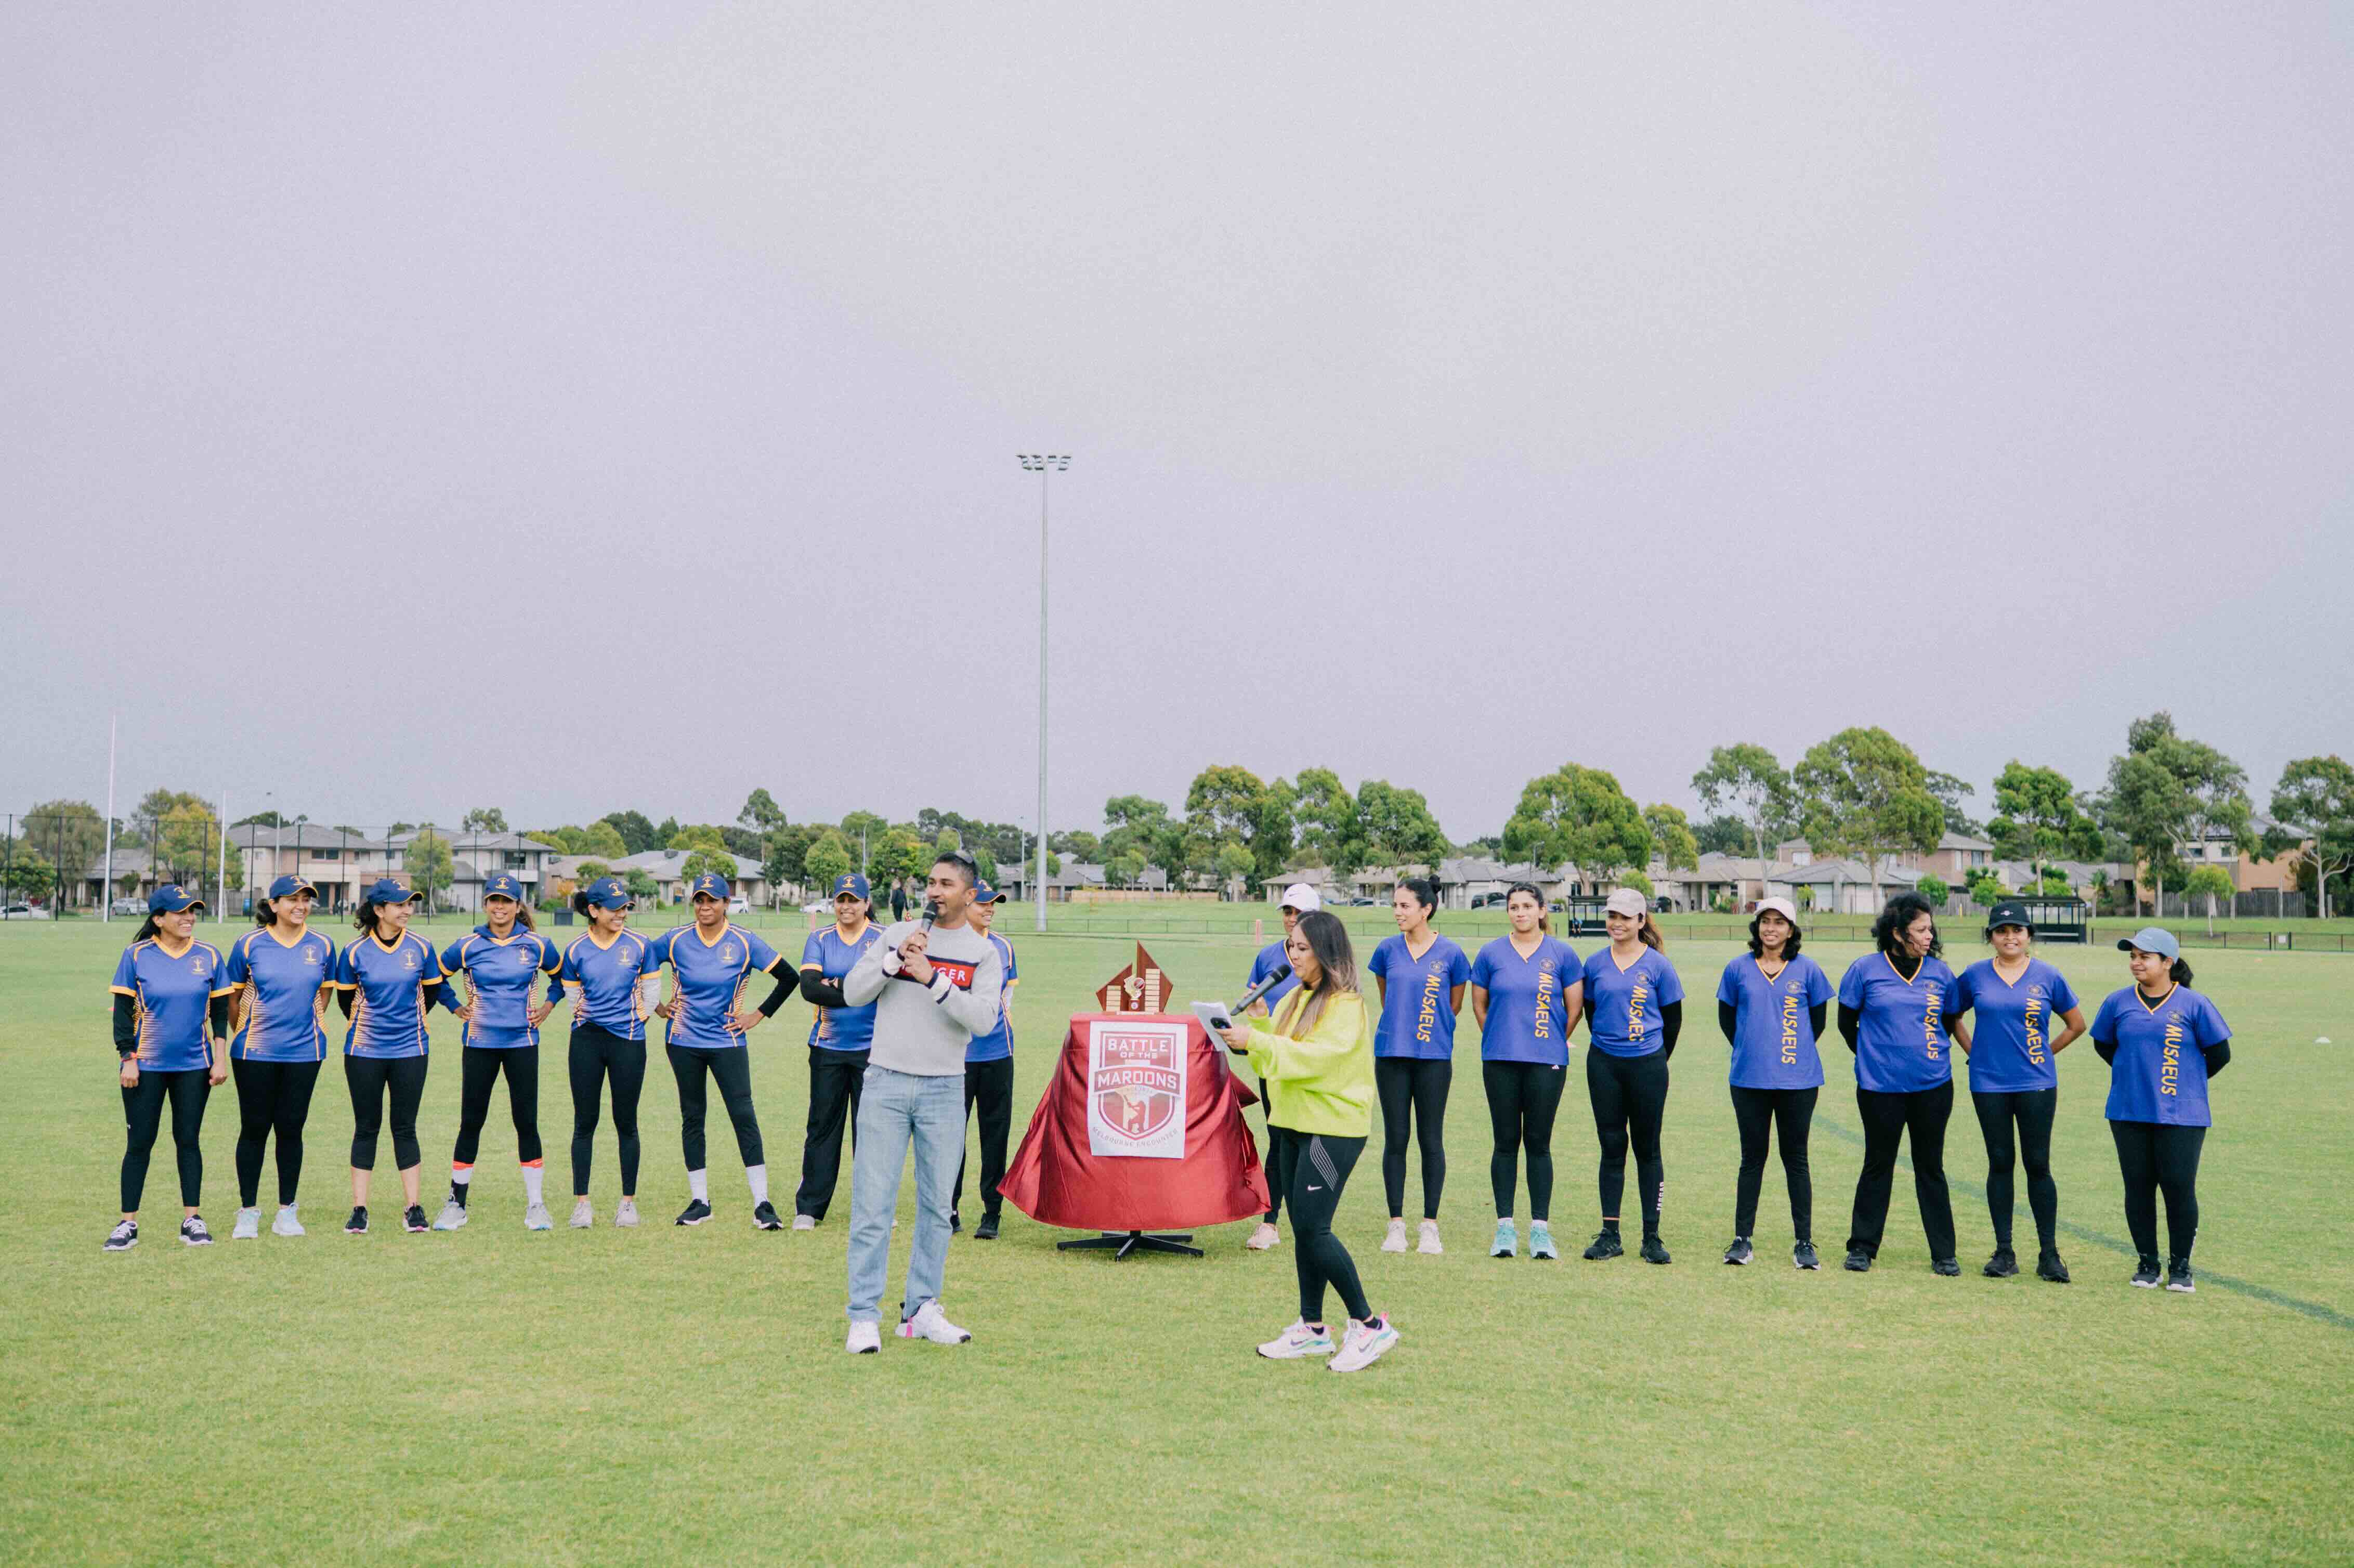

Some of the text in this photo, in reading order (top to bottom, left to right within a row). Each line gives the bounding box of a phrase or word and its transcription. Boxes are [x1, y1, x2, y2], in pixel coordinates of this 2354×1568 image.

[1416, 973, 1442, 1043] MUSAEUS
[1534, 972, 1553, 1039] MUSAEUS
[1781, 995, 1798, 1065] MUSAEUS
[1924, 994, 1941, 1059] MUSAEUS
[2025, 998, 2045, 1065] MUSAEUS
[1108, 1039, 1169, 1052] BATTLE
[2161, 1023, 2183, 1096] MUSAEUS
[1097, 1070, 1177, 1090] MAROONS
